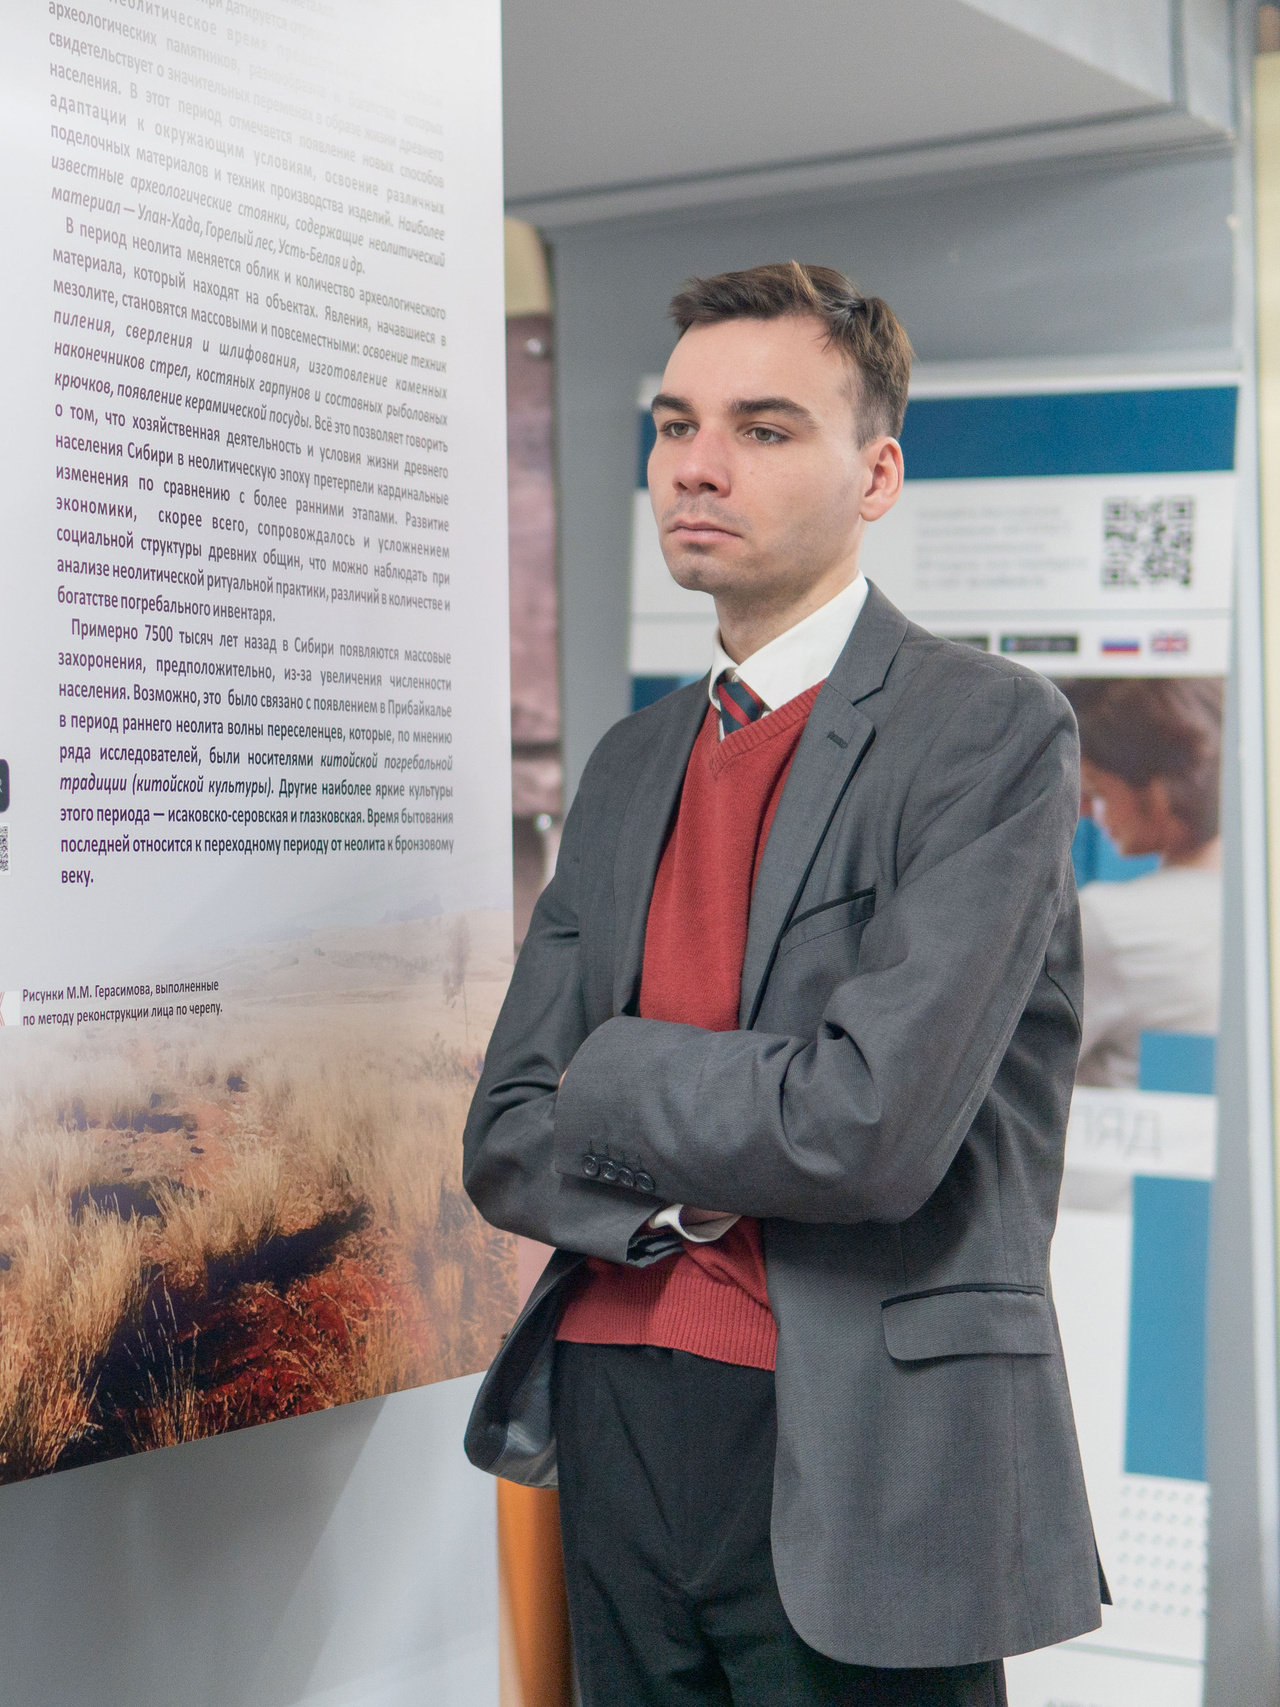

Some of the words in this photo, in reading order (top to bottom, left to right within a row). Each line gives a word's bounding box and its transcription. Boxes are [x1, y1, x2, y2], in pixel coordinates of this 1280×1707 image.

[54, 403, 63, 418] о
[69, 406, 98, 425] том,
[104, 411, 125, 428] что
[132, 415, 220, 443] хозяйственная
[226, 431, 301, 455] деятельность
[307, 444, 314, 457] и
[319, 446, 361, 464] условия
[366, 453, 399, 470] жизни
[403, 459, 448, 478] древнего
[55, 435, 123, 458] населения
[127, 441, 173, 468] Сибири
[177, 453, 184, 466] в
[188, 454, 276, 482] неолитическую
[279, 468, 310, 489] эпоху
[313, 473, 374, 494] претерпели
[377, 482, 449, 505] кардинальные
[56, 466, 128, 489] изменения
[138, 477, 154, 492] по
[163, 480, 230, 502] сравнению
[239, 491, 245, 504] с
[253, 488, 287, 510] более
[295, 498, 344, 517] ранними
[352, 506, 397, 524] этапами.
[405, 509, 449, 531] Развитие
[56, 497, 137, 522] экономики,
[158, 509, 202, 530] скорее
[212, 516, 248, 535] всего,
[257, 522, 355, 546] сопровождалось
[363, 535, 370, 548] и
[377, 537, 450, 558] усложнением
[56, 528, 133, 550] социальной
[140, 537, 201, 560] структуры
[207, 545, 256, 563] древних
[262, 548, 303, 570] общин,
[308, 556, 326, 571] что
[331, 559, 368, 575] можно
[373, 561, 427, 583] наблюдать
[432, 570, 450, 587] при
[56, 559, 109, 577] анализе
[112, 564, 204, 587] неолитической
[206, 574, 273, 594] ритуальной
[275, 581, 329, 601] практики,
[330, 586, 379, 604] различий
[381, 592, 387, 604] в
[388, 592, 443, 610] количестве
[444, 598, 450, 611] и
[57, 585, 118, 609] богатстве
[120, 594, 210, 616] погребального
[212, 604, 275, 625] инвентаря.
[71, 617, 138, 643] Примерно
[144, 623, 173, 643] 7500
[178, 630, 213, 646] тысяч
[219, 633, 238, 648] лет
[244, 635, 277, 655] назад
[282, 638, 288, 651] в
[294, 635, 334, 658] Сибири
[339, 643, 399, 660] появляются
[404, 648, 451, 663] массовые
[58, 652, 146, 673] захоронения,
[156, 658, 275, 681] предположительно,
[284, 667, 312, 681] из-за
[320, 669, 382, 686] увеличения
[389, 674, 451, 690] численности
[58, 683, 130, 701] населения.
[133, 682, 200, 707] Возможно,
[203, 691, 221, 706] это
[227, 688, 258, 708] было
[260, 694, 303, 710] связано
[305, 696, 311, 710] с
[313, 697, 378, 714] появлением
[379, 700, 385, 714] в
[387, 697, 452, 718] Прибайкалье
[59, 714, 66, 729] в
[70, 714, 119, 735] период
[122, 717, 172, 735] раннего
[176, 719, 223, 735] неолита
[227, 721, 263, 736] волны
[267, 723, 345, 743] переселенцев,
[348, 726, 394, 745] которые,
[397, 728, 410, 742] по
[412, 729, 452, 744] мнению
[59, 745, 91, 764] ряда
[99, 744, 201, 766] исследователей,
[209, 745, 240, 764] были
[247, 751, 313, 766] носителями
[320, 749, 378, 768] китойской
[383, 752, 453, 773] погребальной
[59, 776, 127, 796] традиции
[132, 773, 204, 796] (китойской
[208, 776, 274, 798] культуры).
[278, 776, 317, 798] Другие
[321, 777, 371, 795] наиболее
[375, 782, 405, 799] яркие
[408, 783, 453, 800] культуры
[60, 807, 93, 822] этого
[96, 807, 149, 826] периода
[167, 808, 288, 826] исаковско-серовская
[290, 809, 297, 822] и
[299, 809, 364, 823] глазковская.
[367, 805, 399, 826] Время
[400, 805, 453, 823] бытования
[60, 832, 129, 856] последней
[132, 837, 192, 852] относится
[195, 837, 201, 851] к
[204, 837, 281, 855] переходному
[283, 837, 328, 855] периоду
[330, 837, 342, 850] от
[344, 837, 385, 850] неолита
[387, 837, 393, 850] к
[394, 832, 454, 854] бронзовому
[61, 868, 93, 887] веку.
[22, 988, 64, 1004] Рисунки
[66, 985, 92, 999] М.М.
[94, 984, 153, 1000] Герасимова,
[155, 981, 218, 994] выполненные
[22, 1014, 35, 1026] по
[37, 1012, 74, 1026] методу
[76, 1007, 148, 1025] реконструкции
[150, 1006, 174, 1019] лица
[176, 1005, 187, 1015] по
[188, 1003, 222, 1016] черепу.
